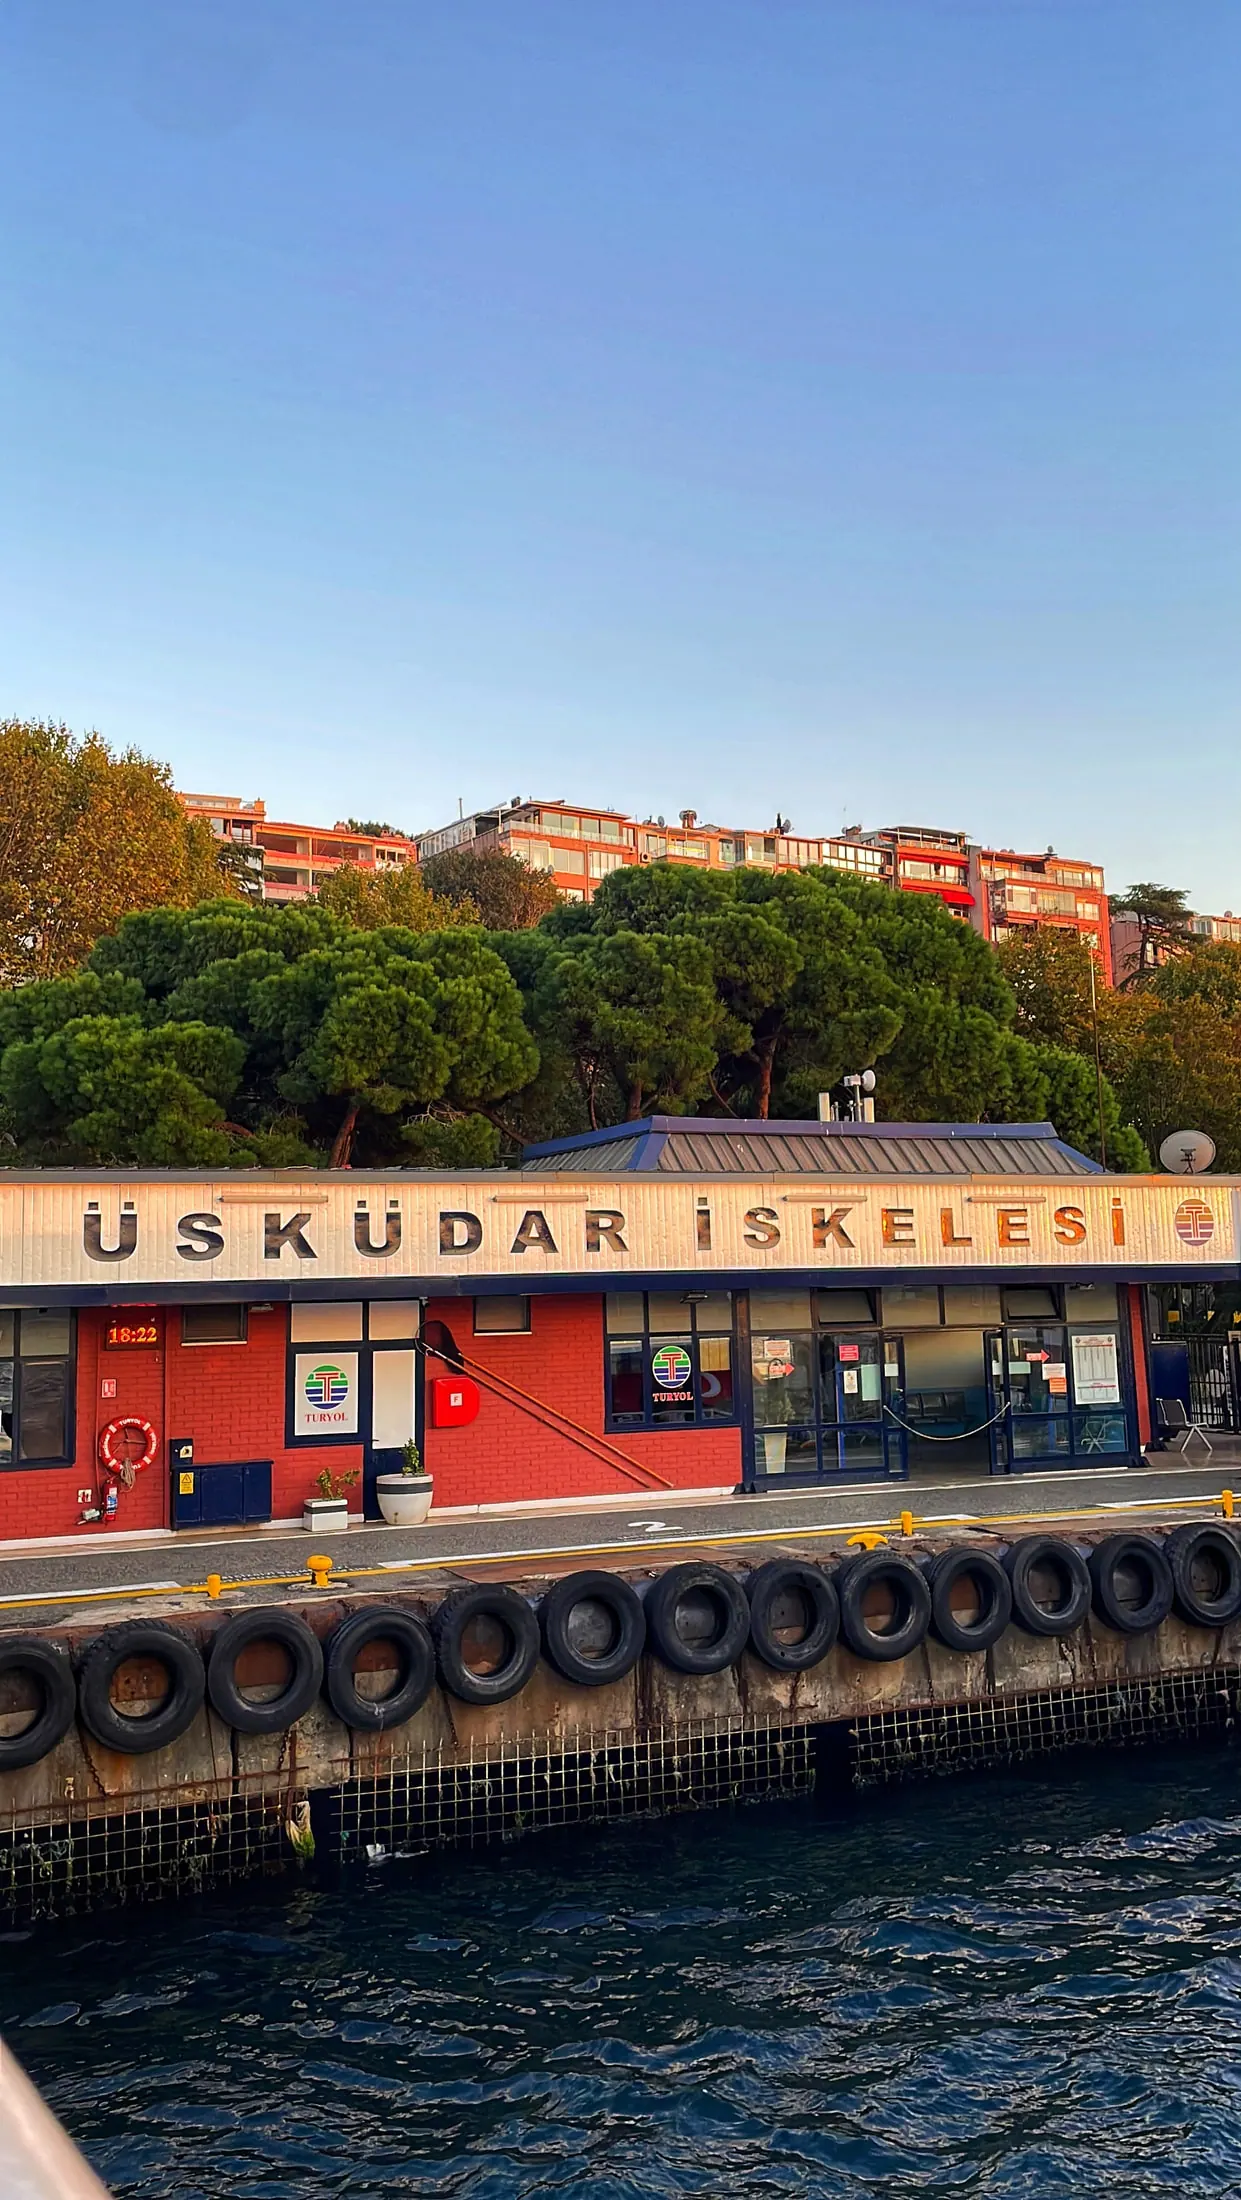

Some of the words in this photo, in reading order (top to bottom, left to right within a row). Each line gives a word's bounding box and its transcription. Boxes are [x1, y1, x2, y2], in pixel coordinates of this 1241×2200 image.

[83, 1200, 629, 1262] ÜSKÜDAR
[696, 1197, 1125, 1251] İSKELESİ
[109, 1327, 157, 1343] 18:22
[652, 1391, 694, 1402] TURYOL
[304, 1412, 348, 1423] TURYOL
